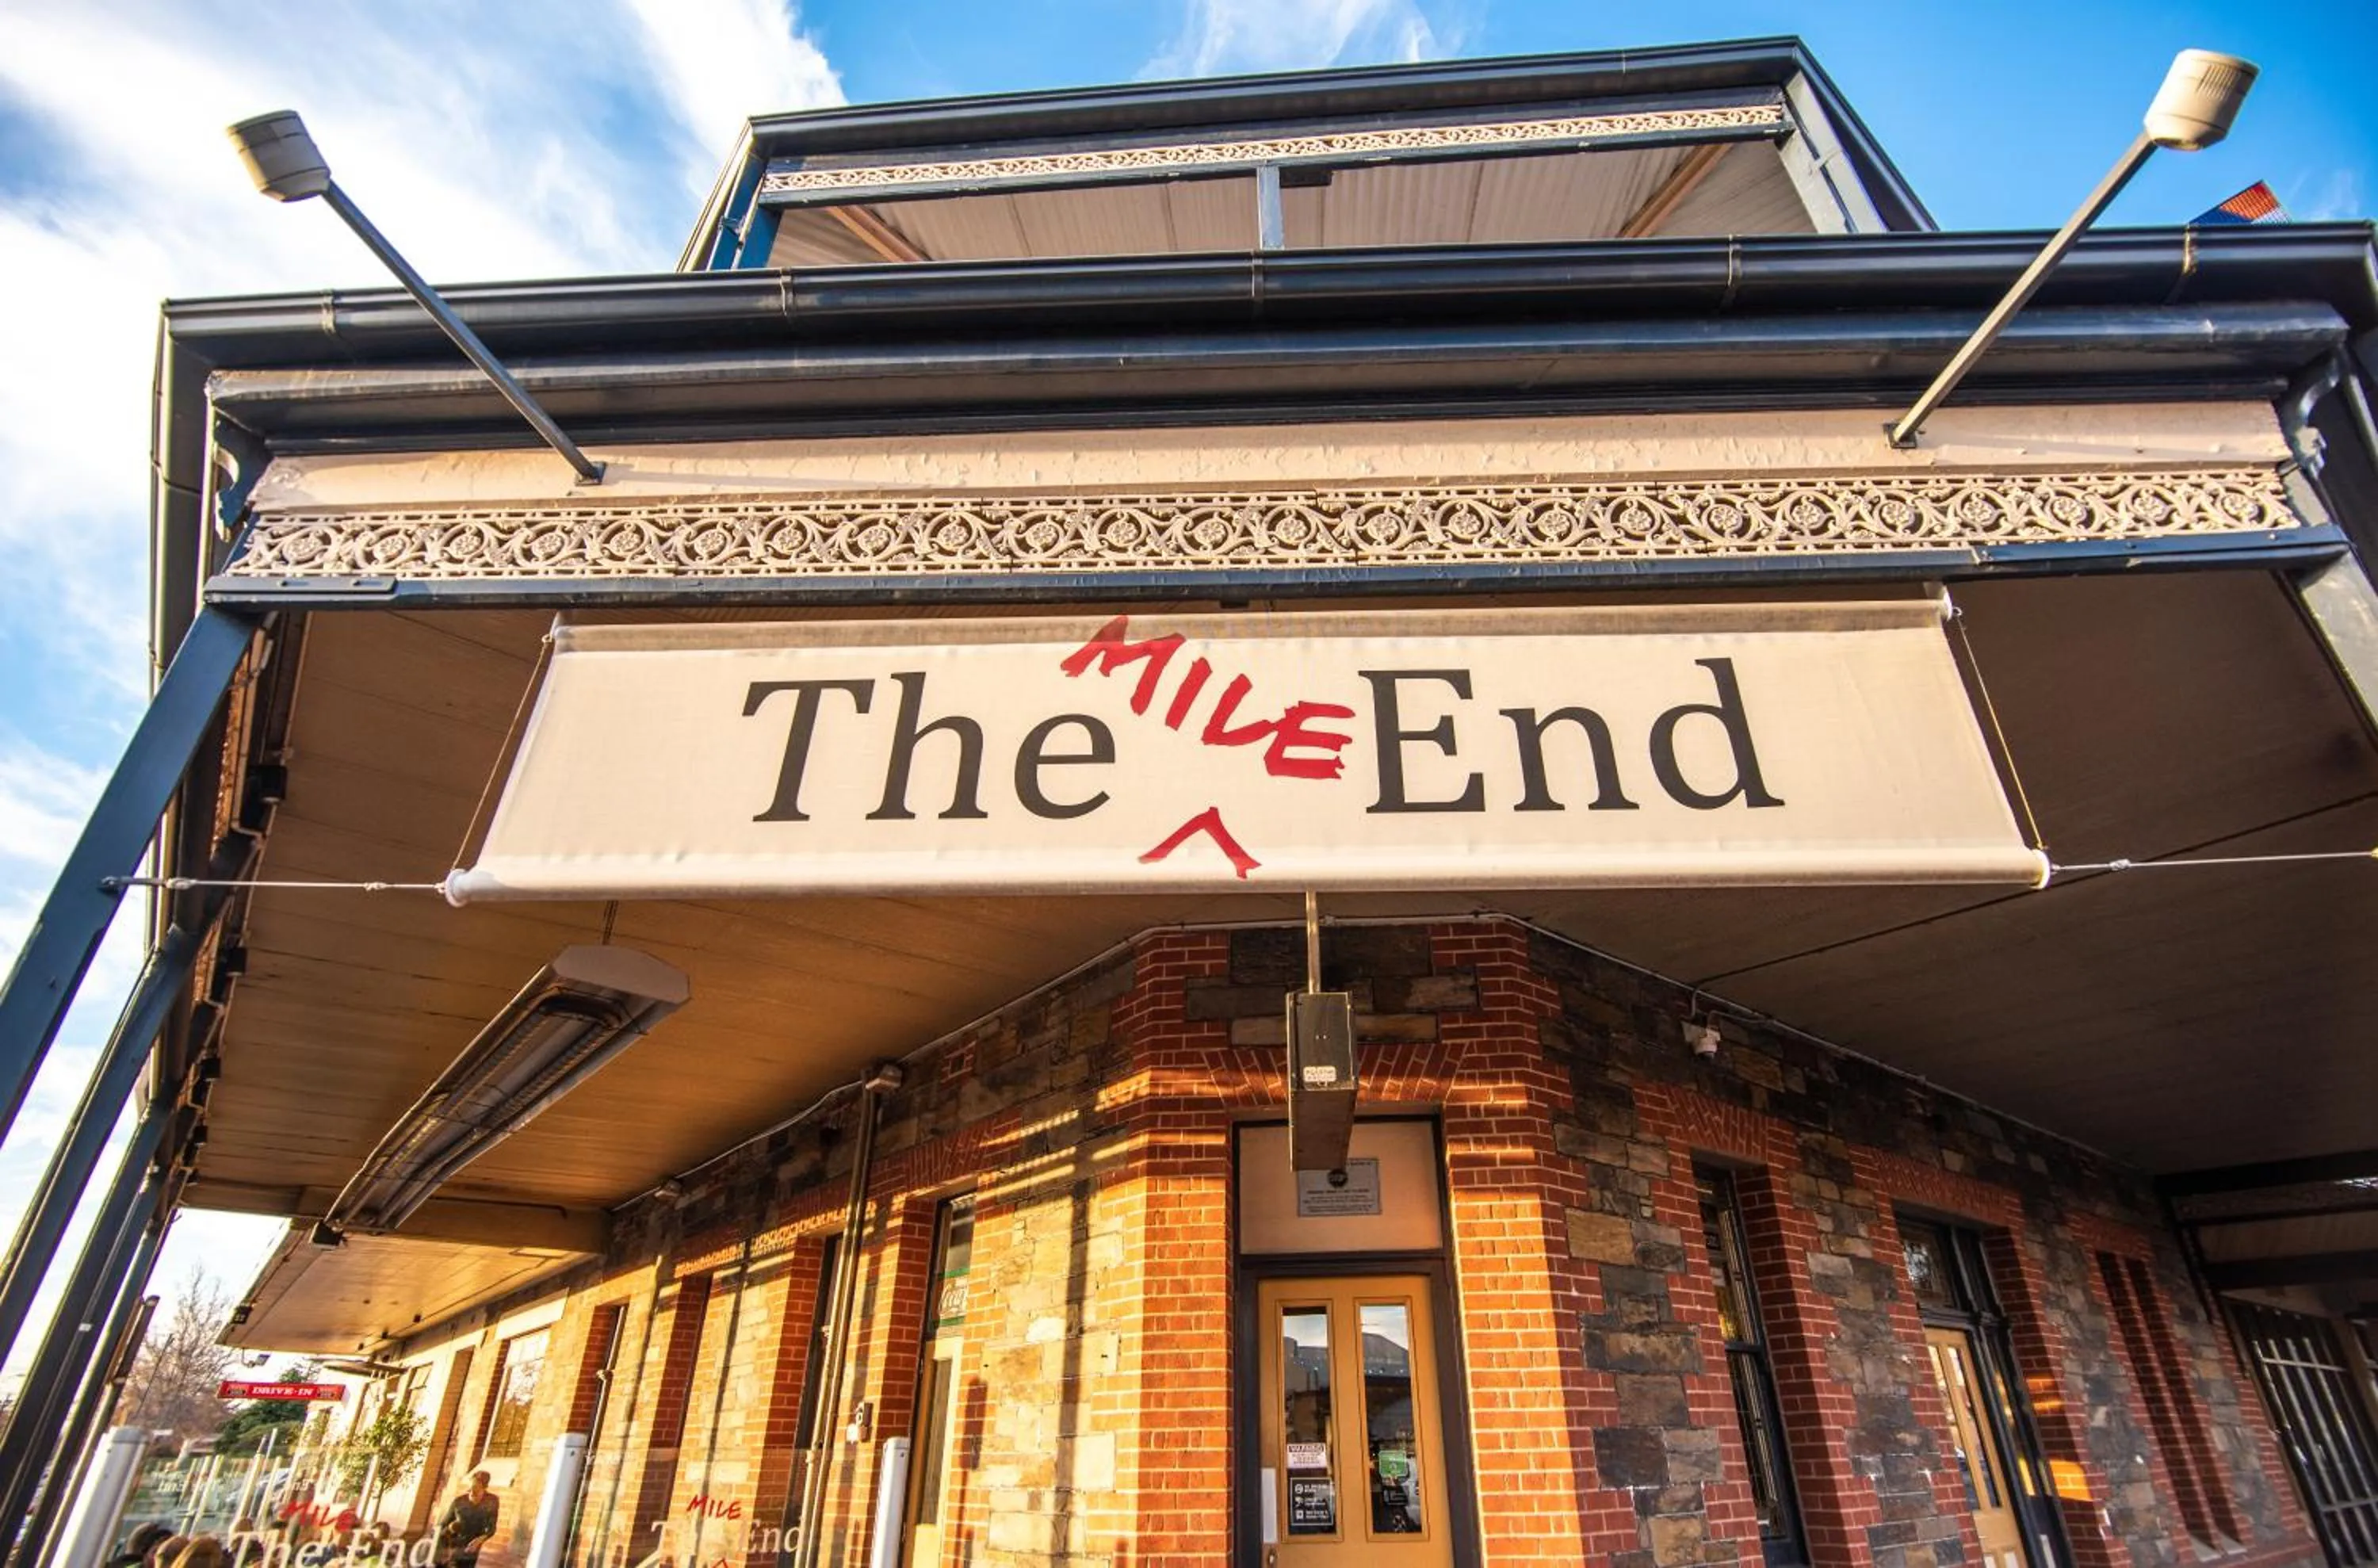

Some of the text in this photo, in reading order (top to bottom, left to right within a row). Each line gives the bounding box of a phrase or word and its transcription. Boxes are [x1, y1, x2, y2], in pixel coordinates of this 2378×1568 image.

[743, 657, 1787, 822] The End
[1060, 614, 1355, 780] MILE
[230, 1522, 442, 1568] The End
[686, 1494, 742, 1521] MILE
